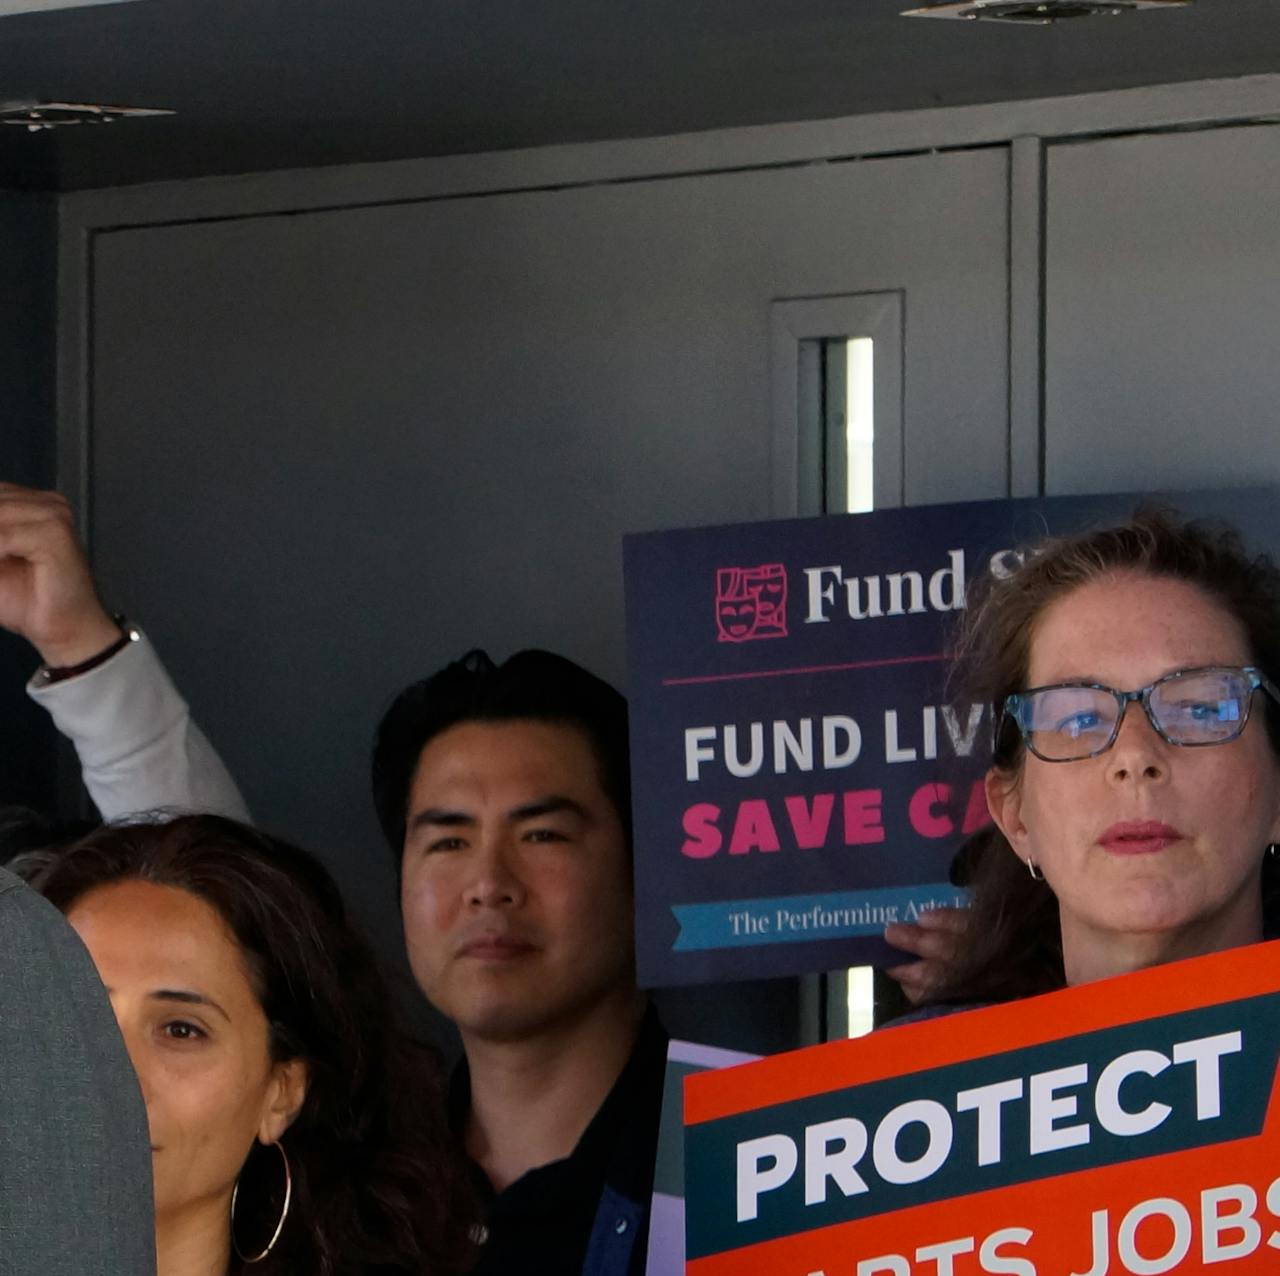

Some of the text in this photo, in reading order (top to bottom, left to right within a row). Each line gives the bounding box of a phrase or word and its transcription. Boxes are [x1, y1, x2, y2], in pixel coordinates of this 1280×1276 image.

[802, 548, 967, 624] Fund
[684, 702, 996, 782] FUND LIV
[680, 788, 886, 861] SAVE
[728, 911, 770, 937] The
[776, 901, 899, 933] Performing
[736, 1029, 1244, 1224] PROTECT
